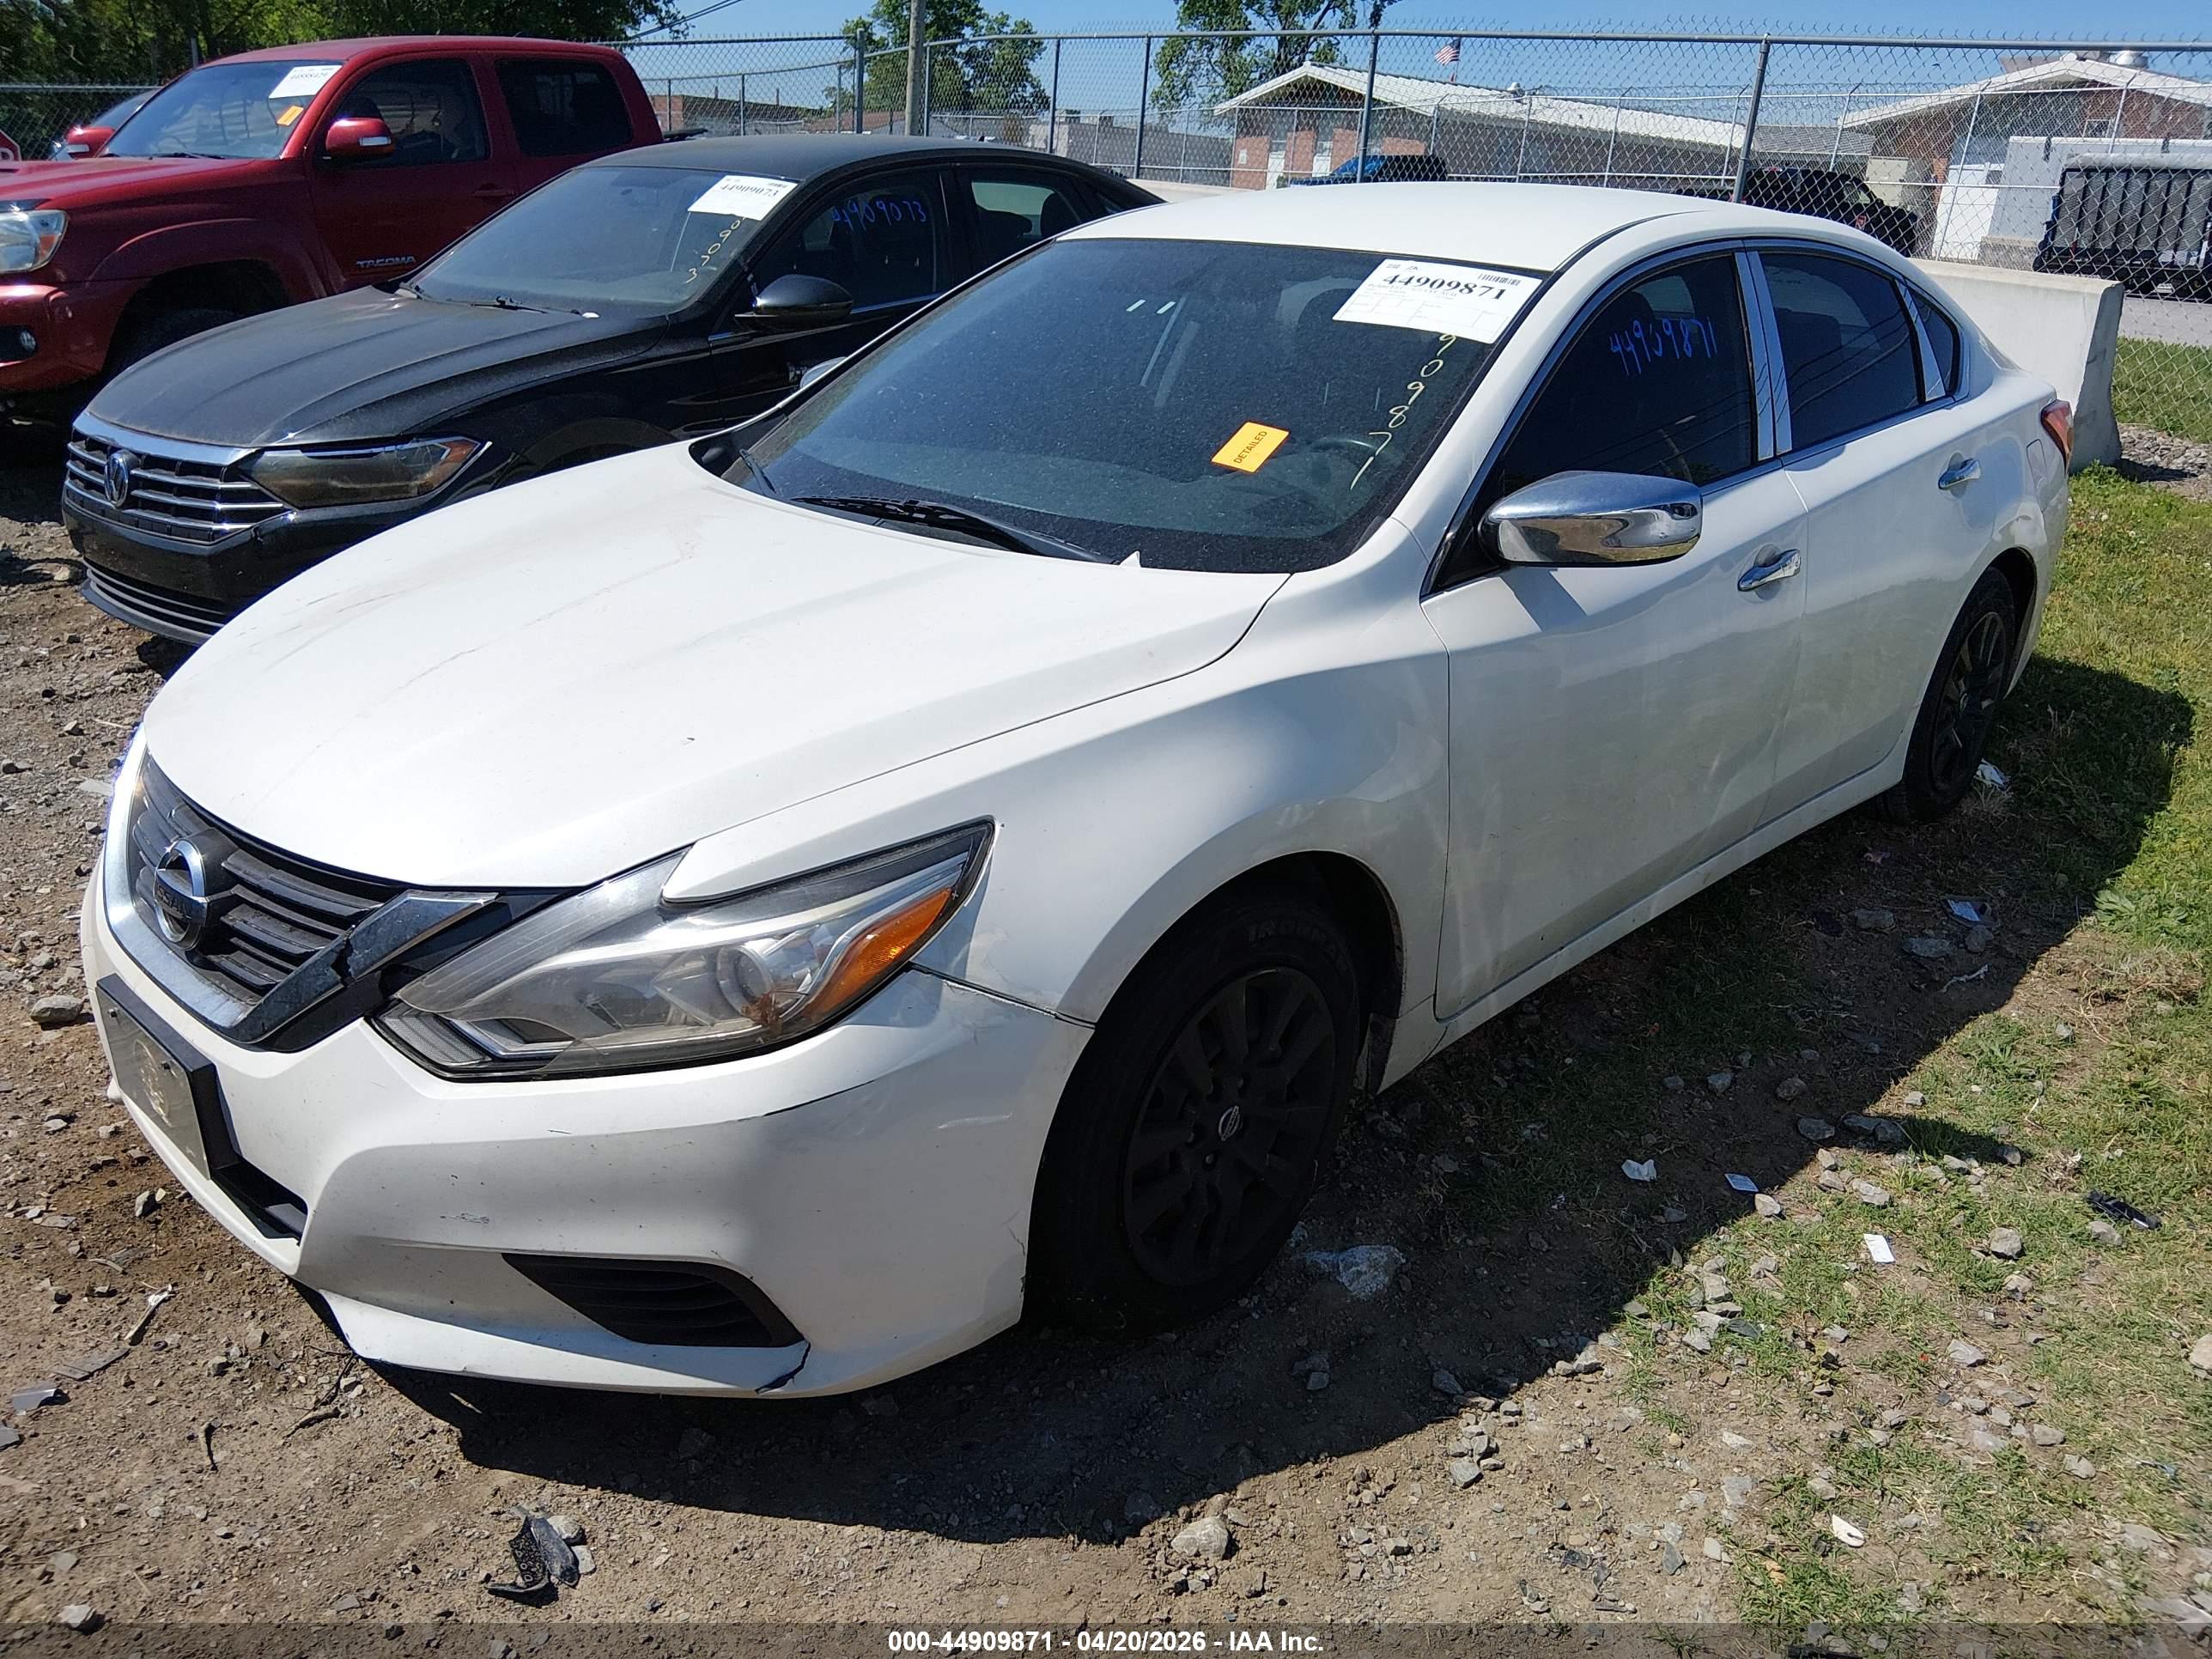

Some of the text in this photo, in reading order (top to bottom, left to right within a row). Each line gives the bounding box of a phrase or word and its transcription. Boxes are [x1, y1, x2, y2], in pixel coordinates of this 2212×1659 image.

[720, 183, 781, 198] 44909073
[356, 256, 416, 268] TACOMA
[1382, 273, 1507, 301] 44909871
[1233, 430, 1267, 464] DETAILED
